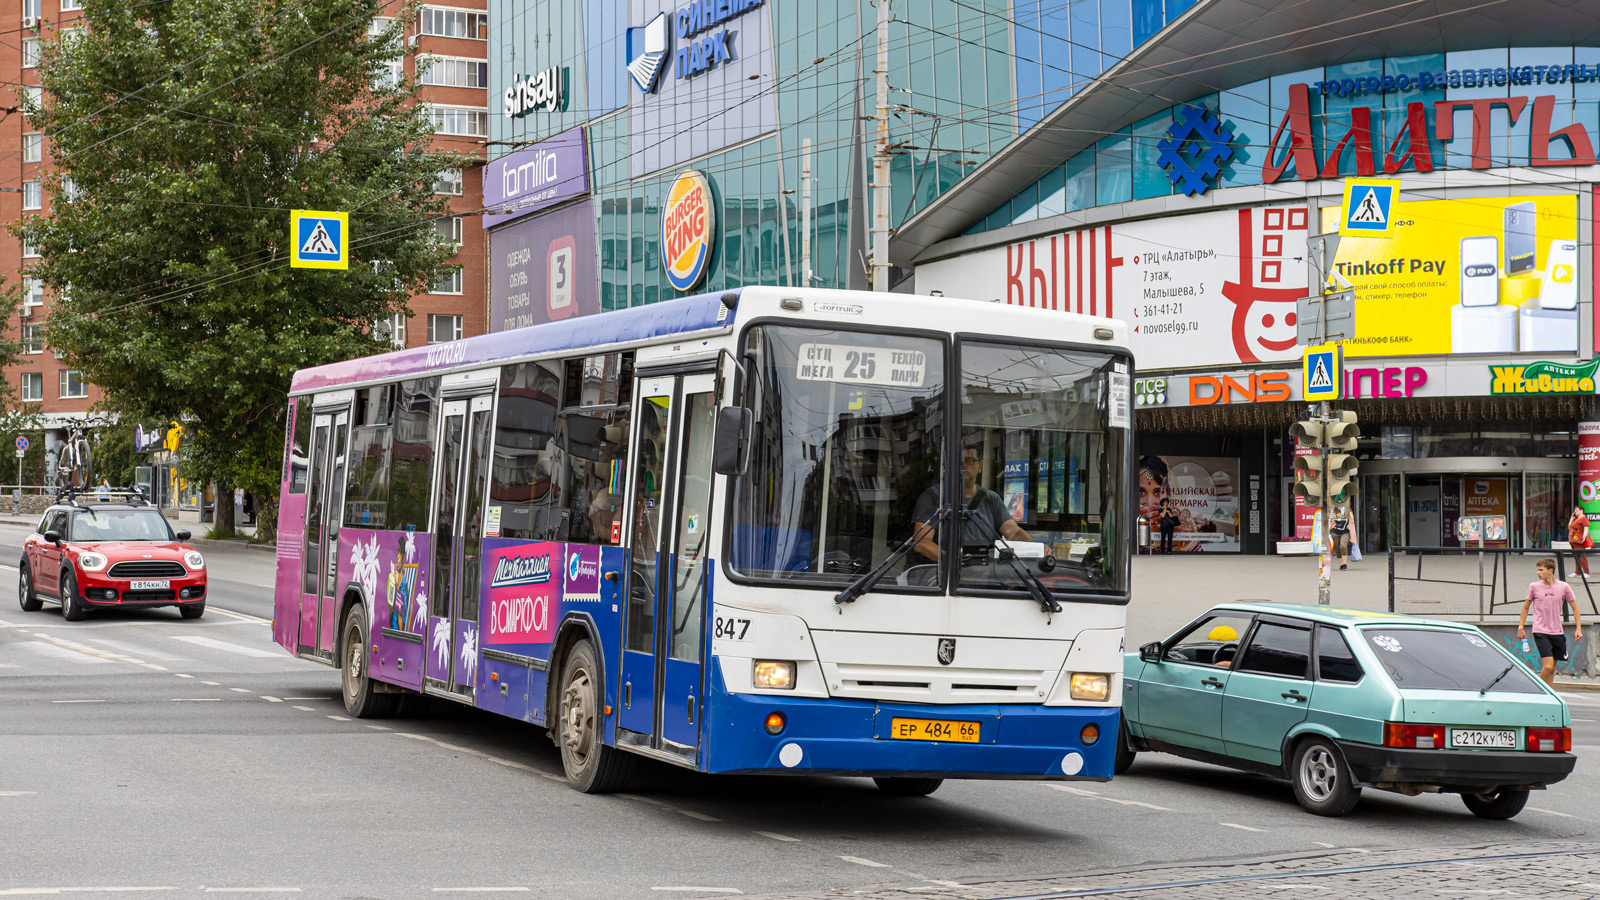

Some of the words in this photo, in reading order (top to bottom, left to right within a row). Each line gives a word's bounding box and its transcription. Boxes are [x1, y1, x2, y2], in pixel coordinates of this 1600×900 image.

[676, 29, 730, 79] ПАРК
[1314, 63, 1600, 97] торгово-развлекатель
[504, 65, 558, 118] sinsay
[503, 148, 557, 199] familia
[666, 186, 702, 240] BURGER
[667, 206, 704, 270] KING
[506, 247, 531, 269] ОДЕЖДА
[1143, 252, 1160, 265] ТРЦ
[1162, 249, 1217, 262] «Алатырь»,
[556, 254, 566, 290] 3
[1335, 258, 1405, 276] Tinkoff
[1410, 259, 1446, 276] Pay
[1477, 267, 1493, 275] PAY
[509, 271, 528, 288] ОБУВЬ
[1143, 270, 1148, 282] 7
[1150, 271, 1172, 282] этаж,
[1143, 286, 1197, 299] Малышева,
[1199, 282, 1205, 294] 5
[1369, 282, 1387, 290] свой
[1388, 281, 1415, 289] способ
[1417, 280, 1447, 288] оплаты:
[507, 292, 530, 310] ТОВАРЫ
[1365, 292, 1393, 300] стикер,
[1395, 291, 1427, 299] телефон
[1143, 302, 1182, 317] 361-41-21
[516, 313, 534, 328] ДОМА
[1389, 335, 1413, 343] БАНК»
[425, 341, 467, 368] NLOTO.RU
[807, 347, 832, 363] СТЦ
[891, 351, 924, 366] ТЕХНО
[801, 364, 834, 379] МЕГА
[843, 350, 876, 380] 25
[1543, 365, 1576, 376] АПТЕКИ
[891, 369, 920, 383] ПАРК
[1343, 367, 1428, 400] ПЕР
[1493, 366, 1594, 393] Живика
[1189, 371, 1291, 405] DNS
[1161, 486, 1216, 497] ИНДИЙСКАЯ
[1169, 498, 1208, 508] ЯРМАРКА
[1467, 496, 1500, 506] АПТЕКА
[491, 600, 497, 634] В
[497, 595, 549, 634] СМАРТФОН
[715, 616, 751, 640] 847
[900, 724, 918, 736] ЕР
[924, 722, 952, 739] 484
[960, 723, 974, 735] 66
[1455, 731, 1496, 745] С212КУ
[1497, 731, 1514, 741] 196
